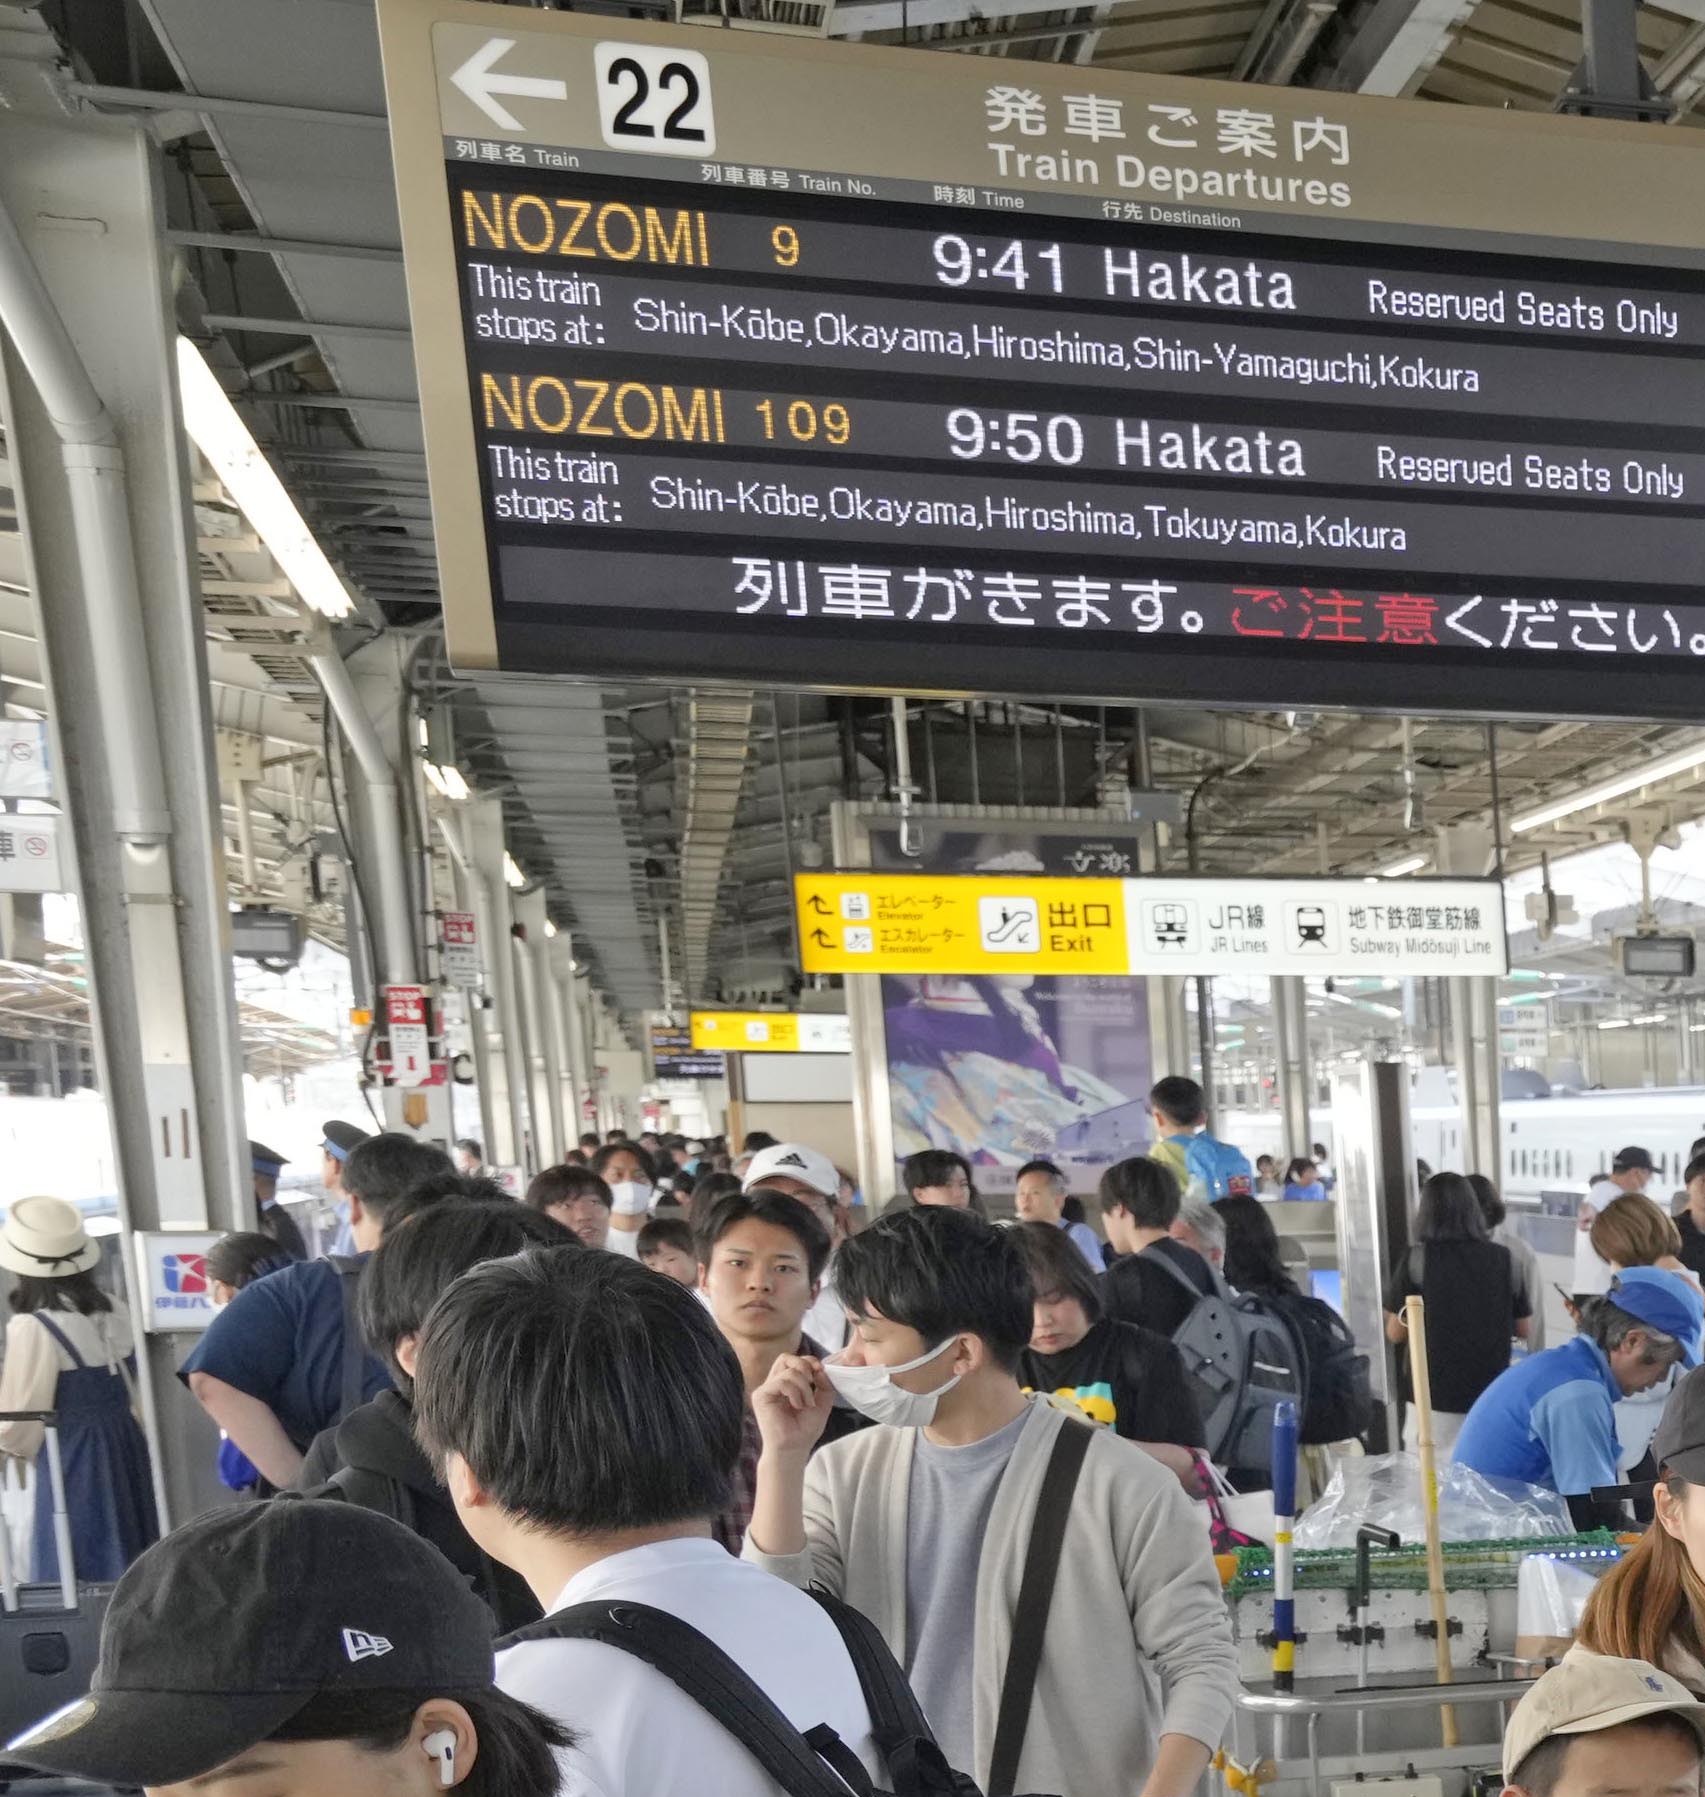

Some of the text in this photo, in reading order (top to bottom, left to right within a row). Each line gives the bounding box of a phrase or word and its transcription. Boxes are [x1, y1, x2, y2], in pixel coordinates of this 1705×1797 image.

[606, 56, 708, 142] 22
[985, 85, 1351, 167] 発車ご案内
[455, 138, 580, 169] 列車名 Train
[700, 163, 877, 196] 列車番号 Train No.
[988, 142, 1352, 208] Train Departures
[933, 184, 1025, 210] 時刻 Time
[1102, 200, 1242, 229] 行先 Destination
[462, 189, 1679, 340] NOZOMI 9 9:41 Hakata Reserved Seats Only
[467, 262, 602, 308] This train
[475, 309, 606, 347] stops at:
[481, 372, 1685, 500] NOZOMI 109 9:50 Hakata Reserved Seats Only
[488, 445, 619, 488] This train
[495, 491, 623, 524] stops at:
[1048, 902, 1112, 929] 出口
[1208, 904, 1266, 930] JR線
[1050, 935, 1094, 952] Exit
[1210, 937, 1269, 954] JR Lines
[1350, 937, 1400, 958] Subway
[1463, 937, 1492, 955] Line
